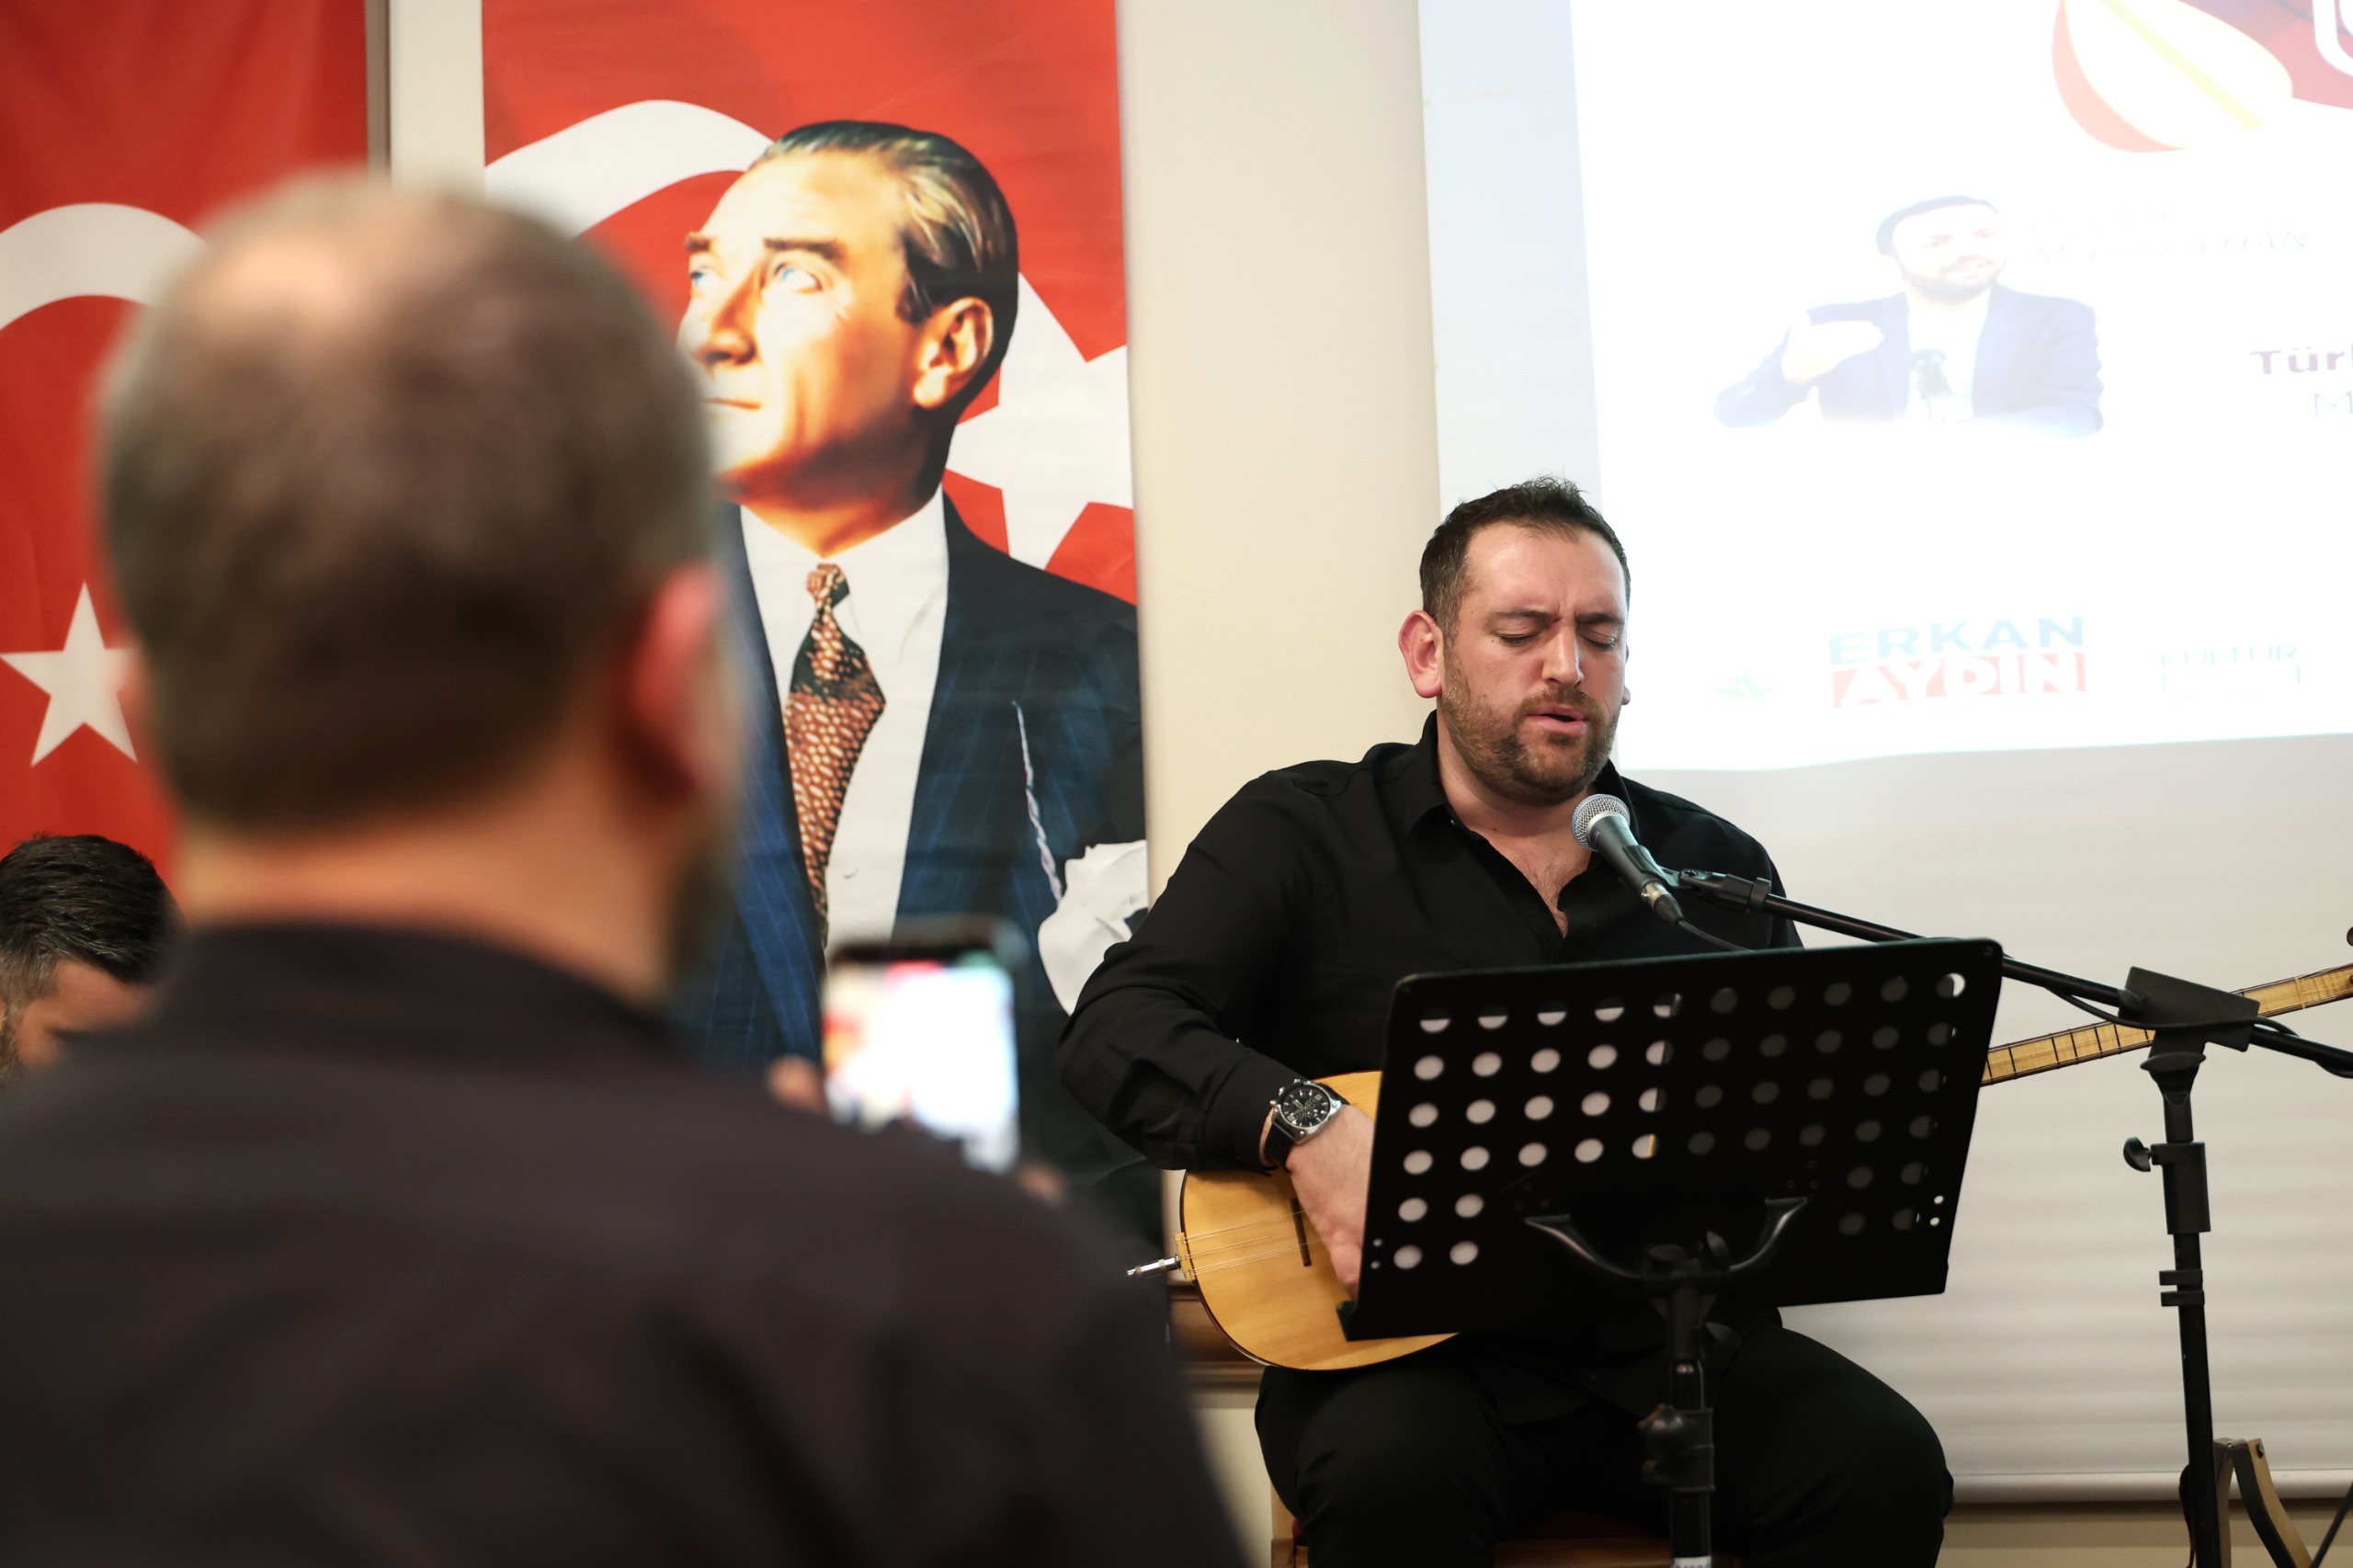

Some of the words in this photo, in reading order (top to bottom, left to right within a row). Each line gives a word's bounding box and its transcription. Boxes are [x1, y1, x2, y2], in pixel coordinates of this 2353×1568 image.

[2249, 344, 2353, 375] Tür
[1829, 616, 2084, 665] ERKAN
[1835, 652, 2081, 708] AYDIN
